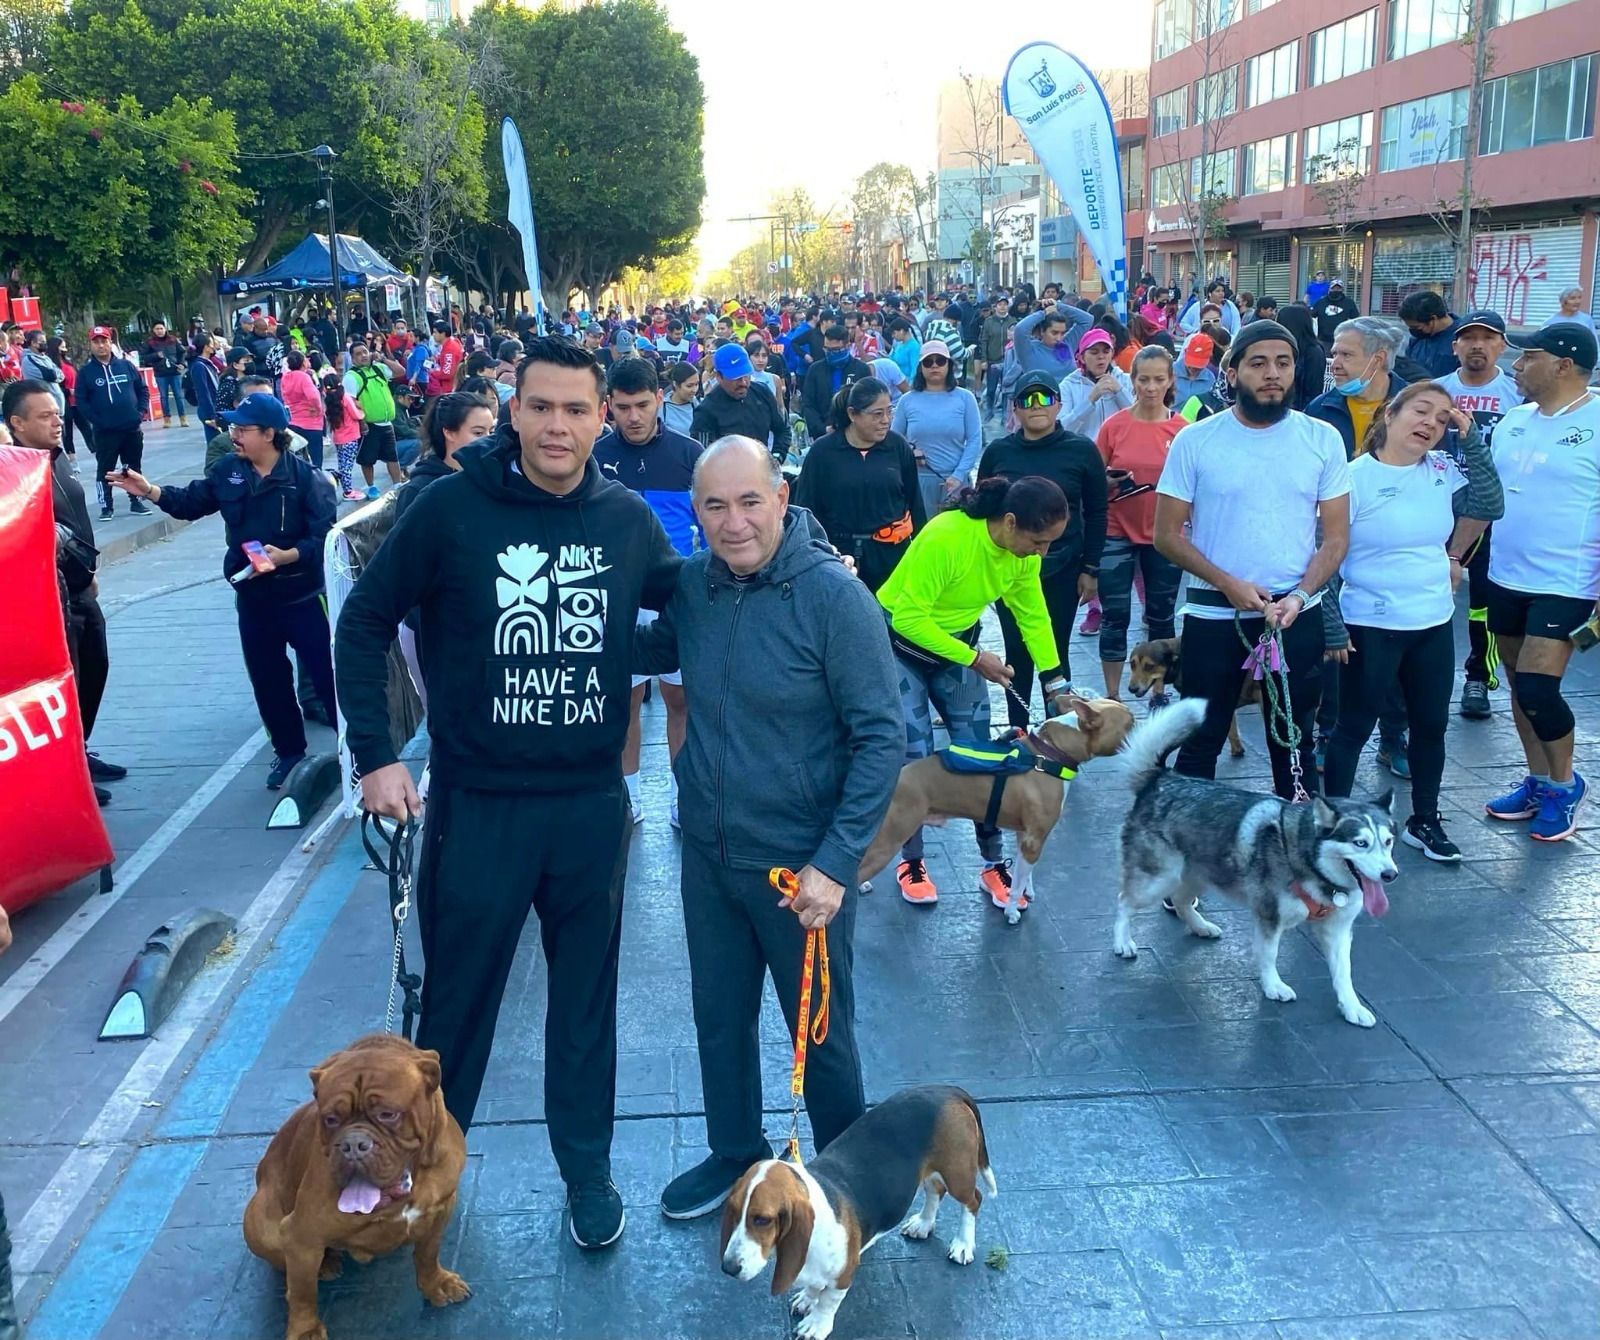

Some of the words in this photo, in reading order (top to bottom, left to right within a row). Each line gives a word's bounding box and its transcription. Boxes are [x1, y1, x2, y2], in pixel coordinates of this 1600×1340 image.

[1026, 111, 1043, 124] San
[1042, 99, 1060, 114] Luis
[1082, 168, 1100, 230] DEPORTE
[559, 544, 602, 569] NIKE
[505, 667, 576, 696] HAVE
[585, 666, 601, 693] A
[493, 697, 554, 725] NIKE
[564, 695, 607, 725] DAY
